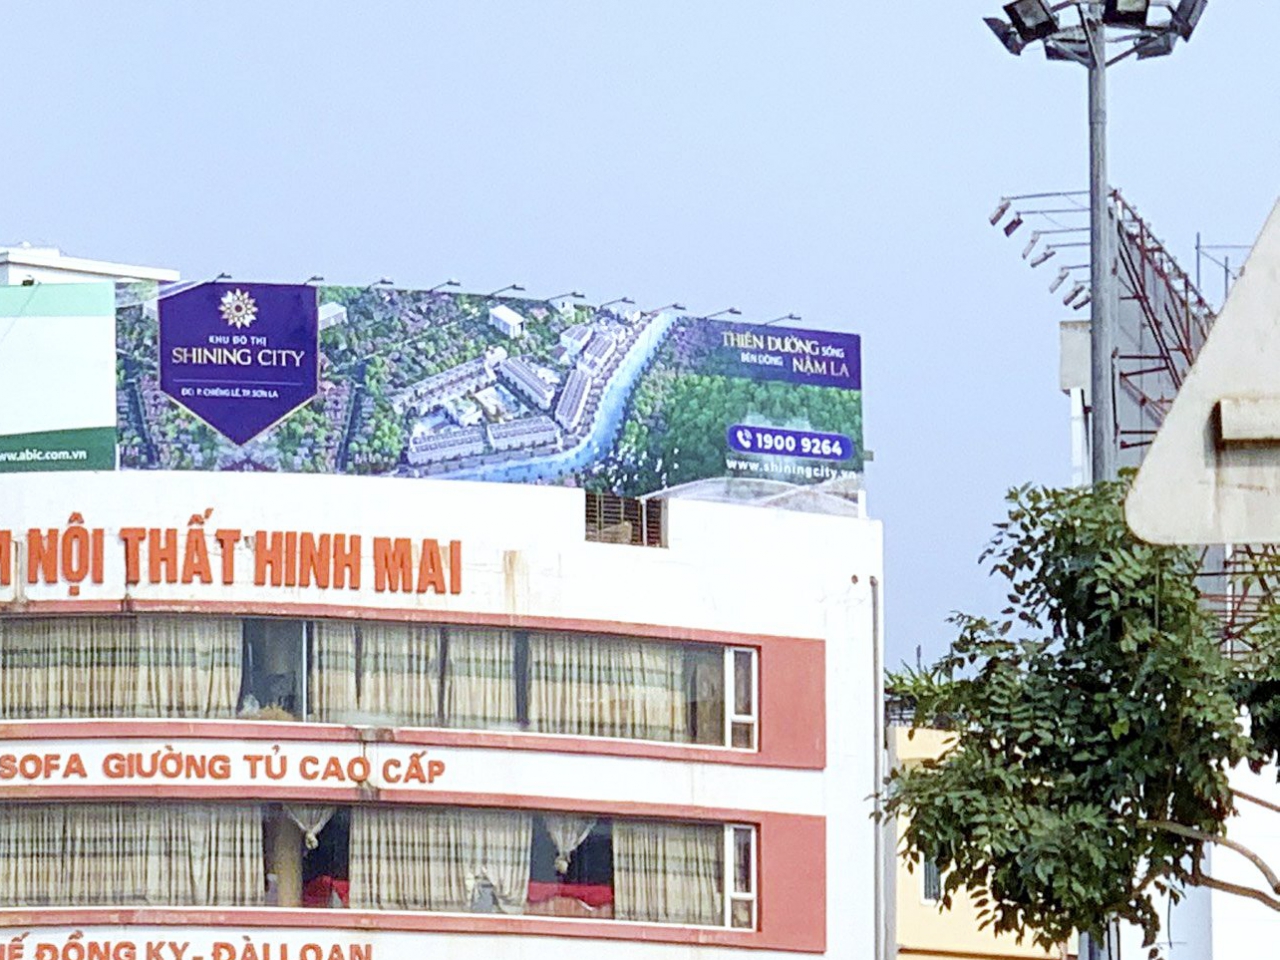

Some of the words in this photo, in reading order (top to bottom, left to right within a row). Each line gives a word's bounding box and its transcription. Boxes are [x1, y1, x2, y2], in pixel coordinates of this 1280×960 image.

[171, 347, 252, 366] SHINING
[257, 349, 306, 367] CITY
[830, 362, 850, 378] LA
[755, 432, 796, 451] 1900
[800, 438, 843, 456] 9264
[725, 458, 857, 480] www.shiningcity.vn
[27, 512, 105, 597] NỘI
[120, 507, 242, 586] THẤT
[254, 530, 362, 590] HINH
[373, 537, 462, 595] MAI
[102, 745, 232, 780] GIƯỜNG
[242, 744, 288, 781] TỦ
[299, 755, 371, 783] CAO
[382, 750, 446, 784] CẤP
